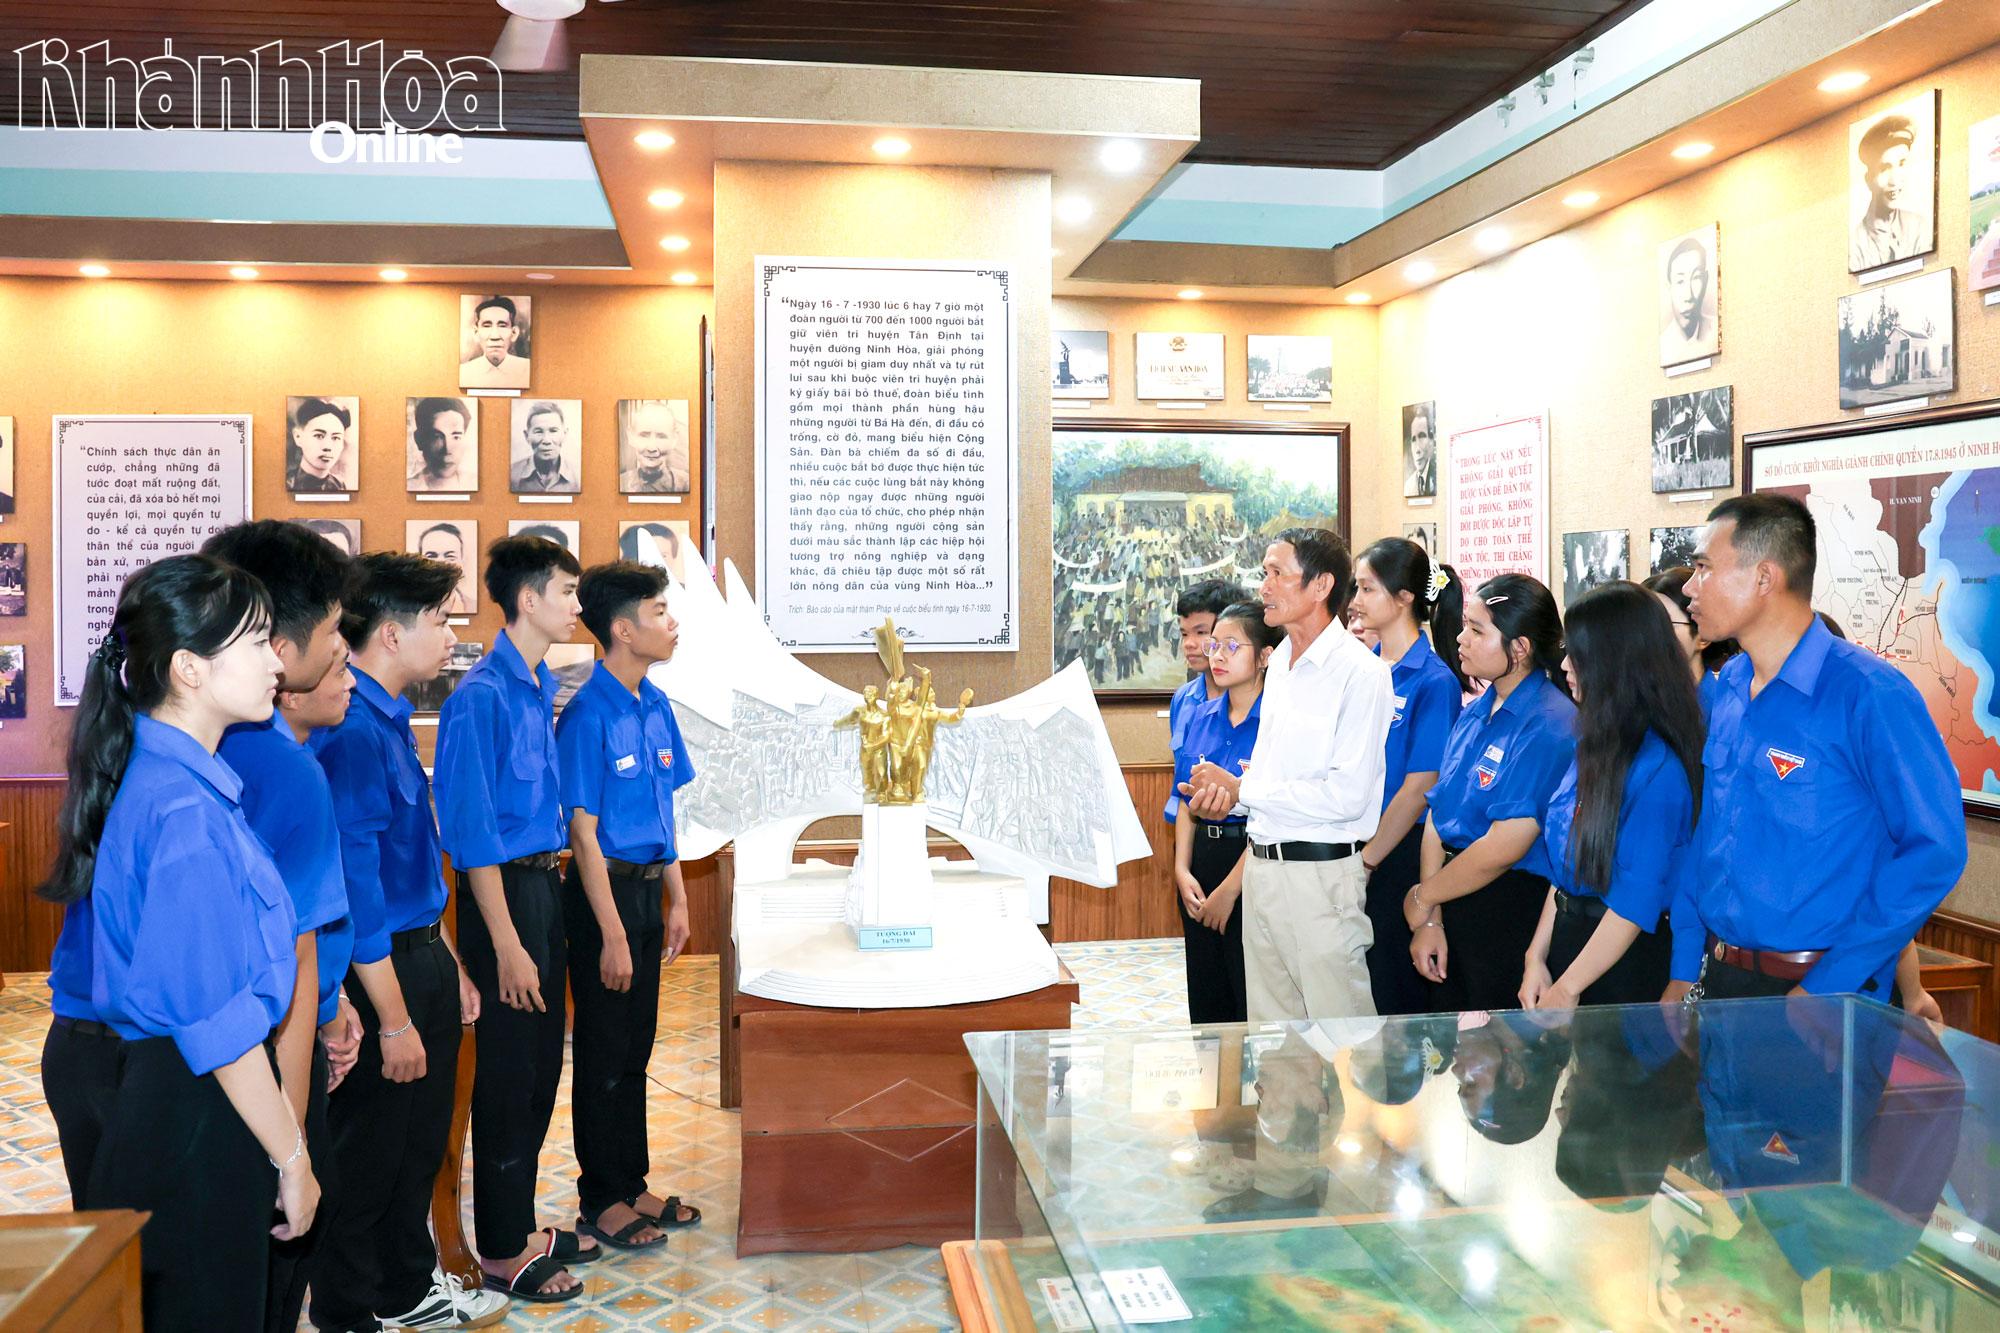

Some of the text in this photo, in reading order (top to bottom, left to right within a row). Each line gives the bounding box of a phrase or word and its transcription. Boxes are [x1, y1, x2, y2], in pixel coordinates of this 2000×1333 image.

[821, 299, 832, 309] 16
[843, 299, 849, 309] 7
[903, 300, 909, 310] 6
[912, 300, 931, 313] hay
[964, 301, 983, 313] một
[819, 314, 932, 326] người 700 1000
[815, 329, 838, 339] viên
[867, 329, 899, 342] huyện
[908, 330, 928, 340] Tân
[827, 344, 861, 356] đường
[866, 344, 891, 354] Ninh
[789, 358, 810, 370] một
[813, 358, 843, 371] người
[860, 359, 886, 371] giam
[939, 359, 951, 369] và
[789, 373, 877, 386] lui sau khi buộc
[822, 403, 842, 415] mọi
[789, 417, 945, 430] những người đi
[866, 433, 984, 445] mang hiện Cộng
[123, 446, 148, 456] sách
[153, 446, 176, 459] thực
[182, 446, 202, 456] dân
[906, 447, 919, 457] đa
[926, 445, 939, 457] số
[945, 448, 955, 458] đi
[1925, 448, 1956, 462] 17.8.1945
[1968, 443, 1990, 457] NINH
[86, 462, 115, 475] cướp,
[165, 462, 199, 475] những
[822, 462, 965, 475] cuộc được thực hiện
[86, 475, 220, 490] tước đoạt mất ruộng đất,
[832, 477, 984, 489] các không
[86, 493, 105, 503] của
[145, 493, 163, 503] xóa
[182, 491, 199, 503] hết
[201, 493, 221, 506] mọi
[789, 491, 907, 504] giao nộp ngay được
[124, 509, 140, 522] lợi,
[147, 509, 166, 522] mọi
[906, 506, 955, 519] cho phép
[86, 525, 100, 535] do
[207, 525, 221, 535] do
[854, 521, 958, 534] những người cộng
[86, 541, 110, 551] thân
[140, 541, 159, 551] của
[165, 541, 194, 554] người
[919, 536, 985, 548] các hiệp hội
[790, 551, 820, 563] tương
[854, 551, 881, 563] nông
[890, 550, 927, 563] nghiệp
[936, 550, 948, 560] và
[897, 565, 923, 578] được
[928, 565, 948, 578] một
[952, 563, 966, 575] số
[86, 572, 109, 585] phải
[790, 580, 806, 590] lớn
[812, 580, 839, 593] nông
[844, 580, 864, 590] dân
[926, 580, 950, 590] Ninh
[87, 603, 115, 616] trong
[87, 635, 102, 645] củ
